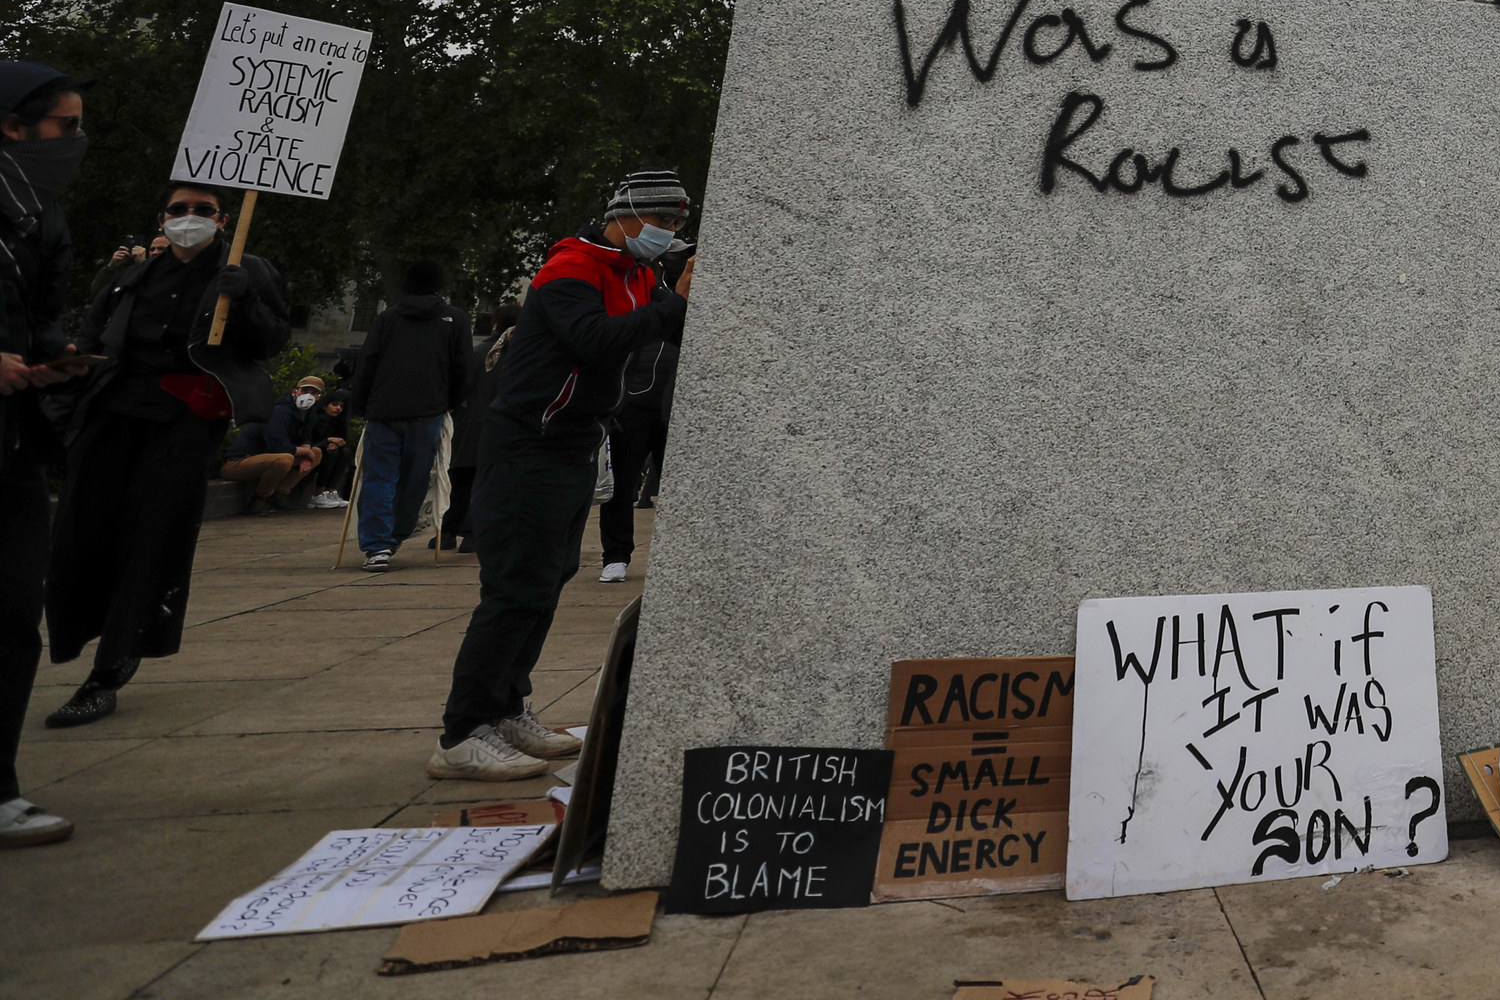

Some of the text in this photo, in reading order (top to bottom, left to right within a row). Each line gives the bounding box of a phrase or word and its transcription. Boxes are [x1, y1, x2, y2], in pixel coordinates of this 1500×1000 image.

[221, 9, 368, 63] Let's put an end to
[1231, 17, 1278, 70] a
[238, 88, 325, 127] RACISM
[260, 117, 274, 134] &
[228, 130, 304, 161] STATE
[1105, 603, 1300, 691] WHAT
[900, 670, 1075, 727] RACISM
[1201, 677, 1393, 742] IT WAS
[725, 750, 859, 787] BRITISH
[909, 755, 1051, 798] SMALL
[697, 791, 886, 824] COLONIALISM
[1185, 739, 1343, 842] YOUR
[925, 797, 1017, 834] DICK
[1250, 795, 1372, 877] SON
[720, 829, 815, 855] IS TO
[893, 830, 1047, 879] ENERGY
[703, 861, 828, 900] BLAME
